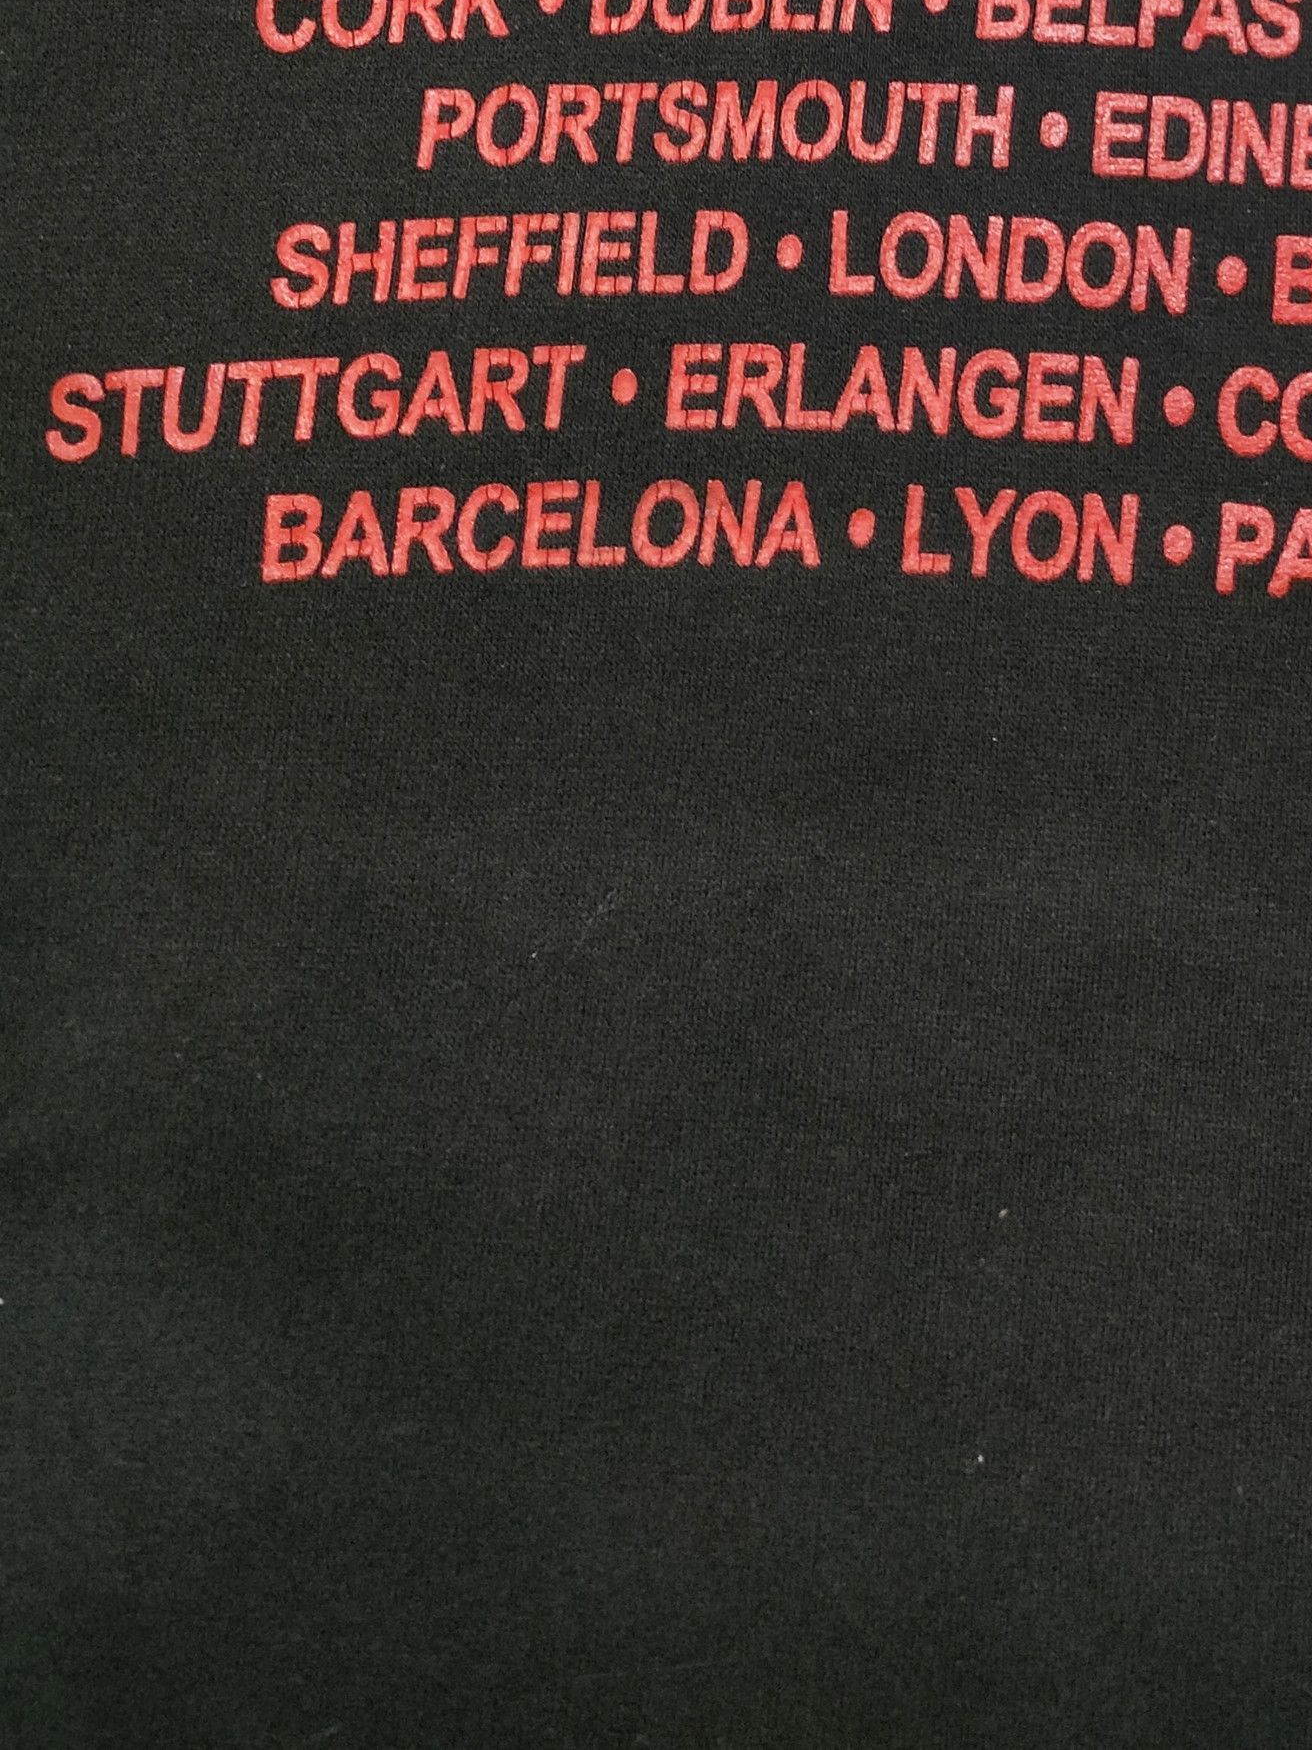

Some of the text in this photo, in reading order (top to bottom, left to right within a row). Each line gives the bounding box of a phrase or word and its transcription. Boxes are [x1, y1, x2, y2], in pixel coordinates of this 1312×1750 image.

[414, 76, 1017, 172] PORTSMOUTH
[268, 207, 752, 313] SHEFFIELD
[826, 207, 1195, 317] LONDON
[42, 342, 588, 465] STUTTGART
[663, 340, 1142, 449] ERLANGEN
[258, 477, 823, 585] BARCELONA
[899, 482, 1143, 588] LYON
